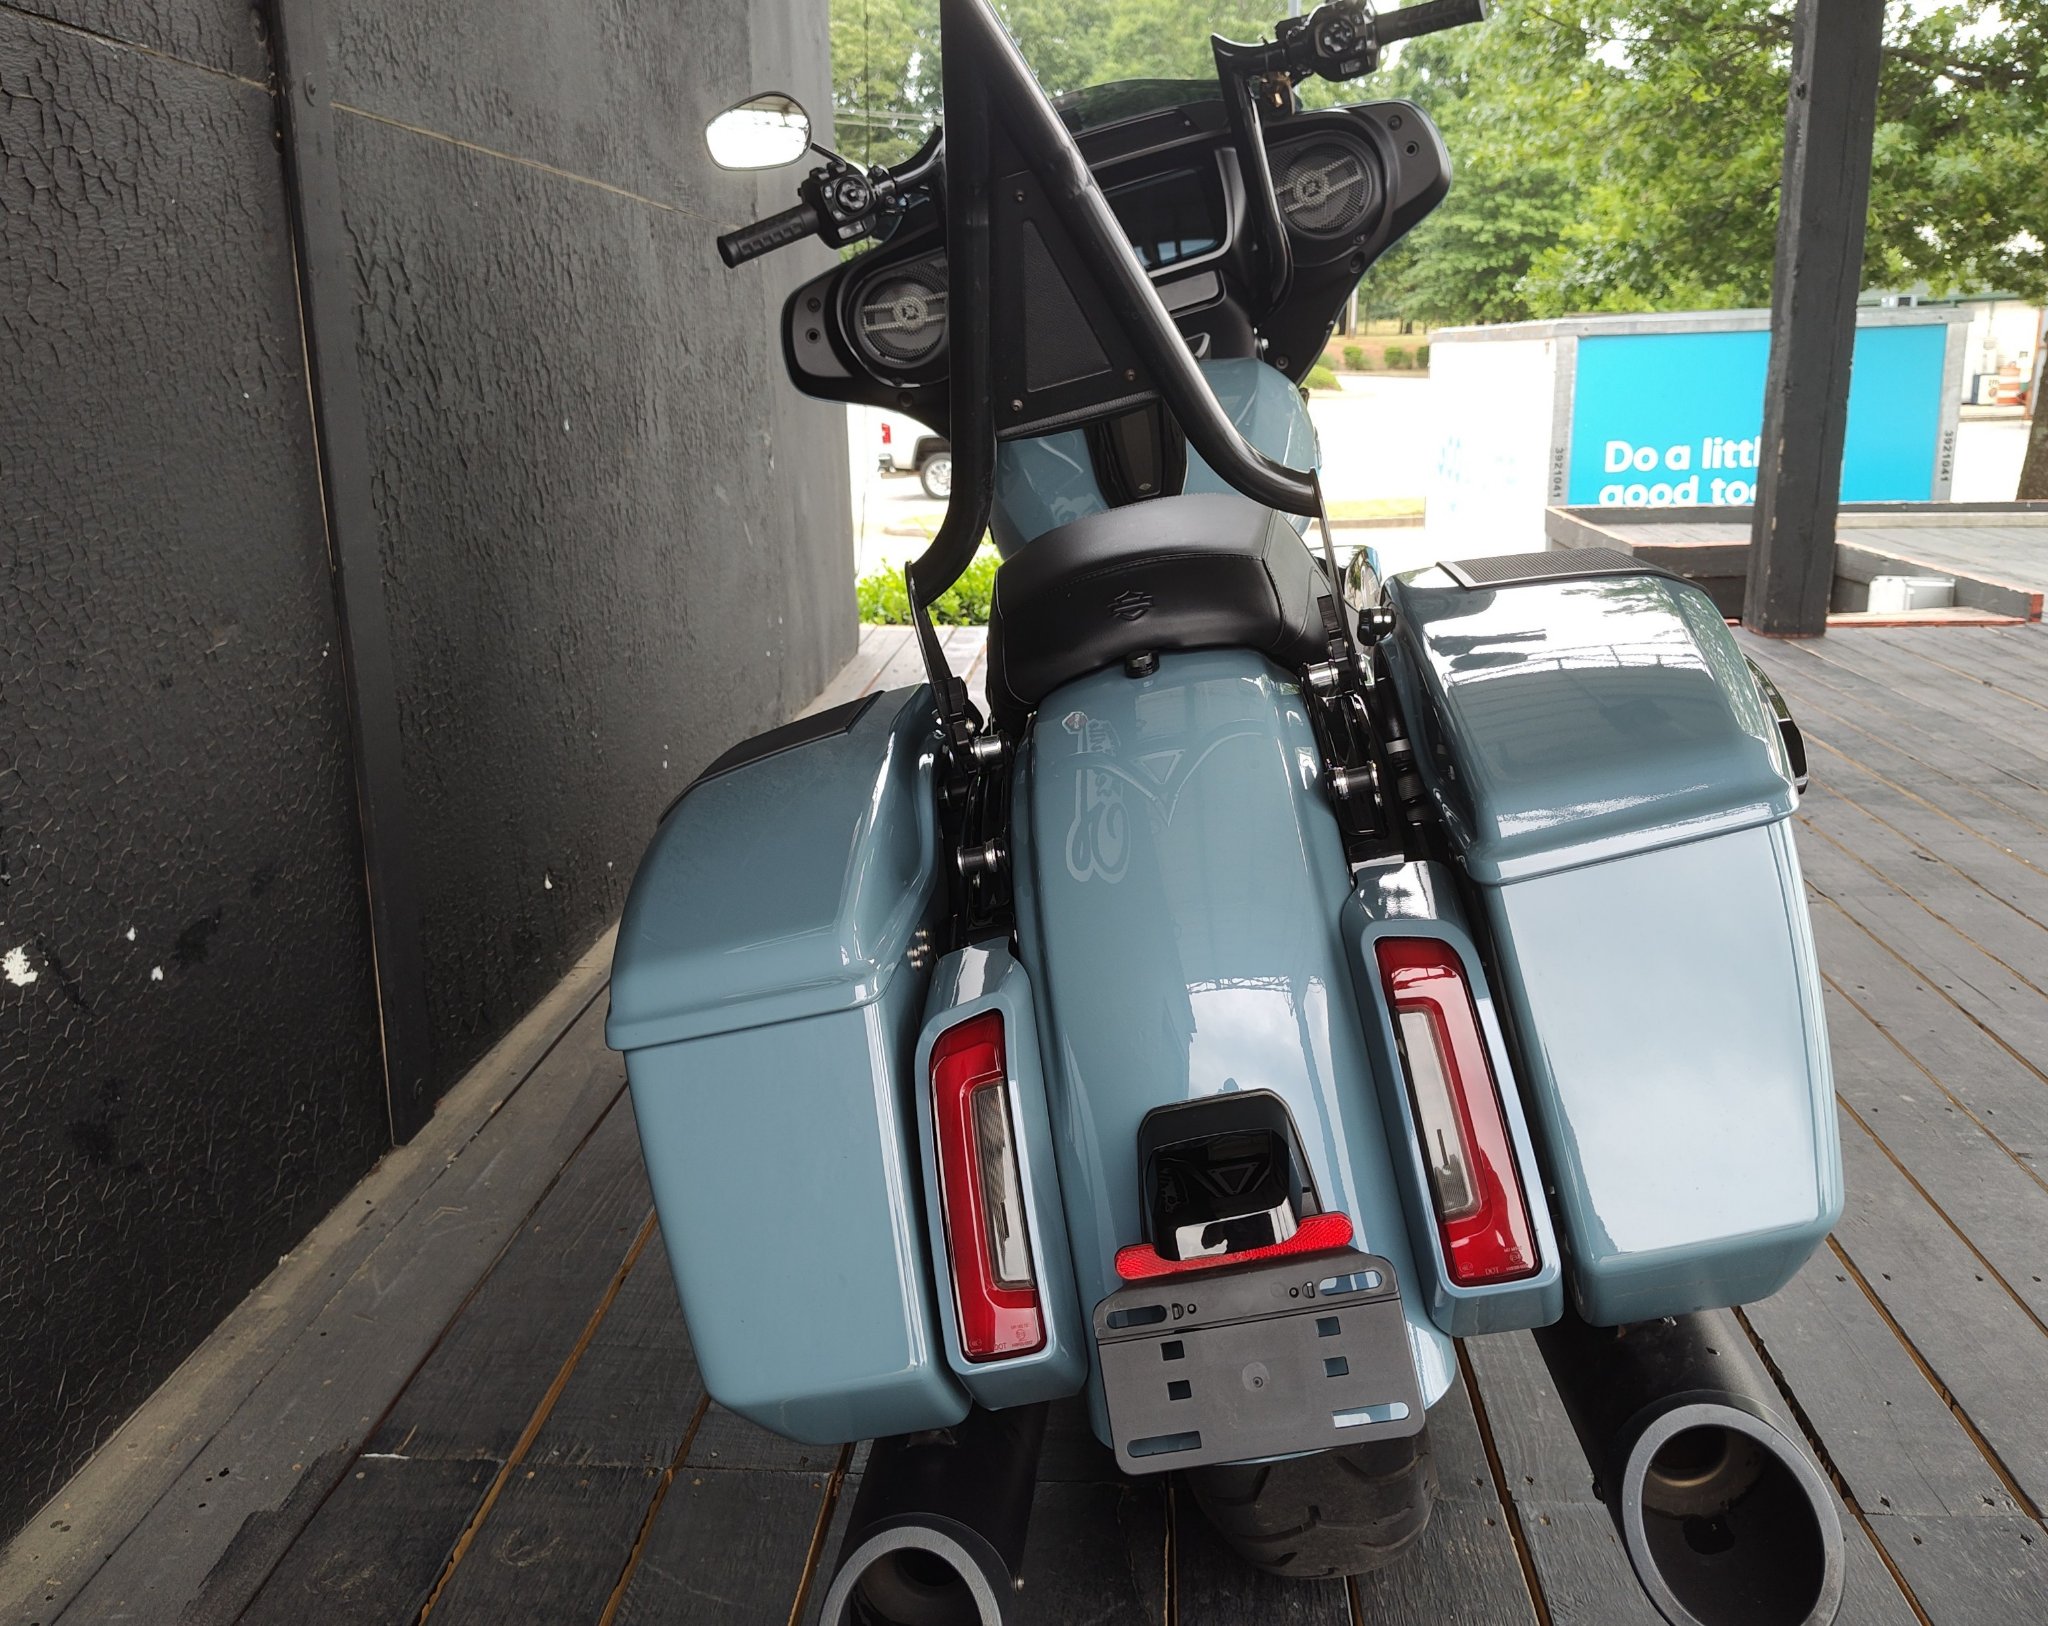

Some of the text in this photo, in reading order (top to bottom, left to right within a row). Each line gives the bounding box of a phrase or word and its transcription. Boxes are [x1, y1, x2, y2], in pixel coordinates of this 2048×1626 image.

[1553, 447, 1564, 498] 3921041
[1604, 440, 1659, 473] Do
[1664, 445, 1691, 470] a
[1940, 430, 1954, 481] 3921041
